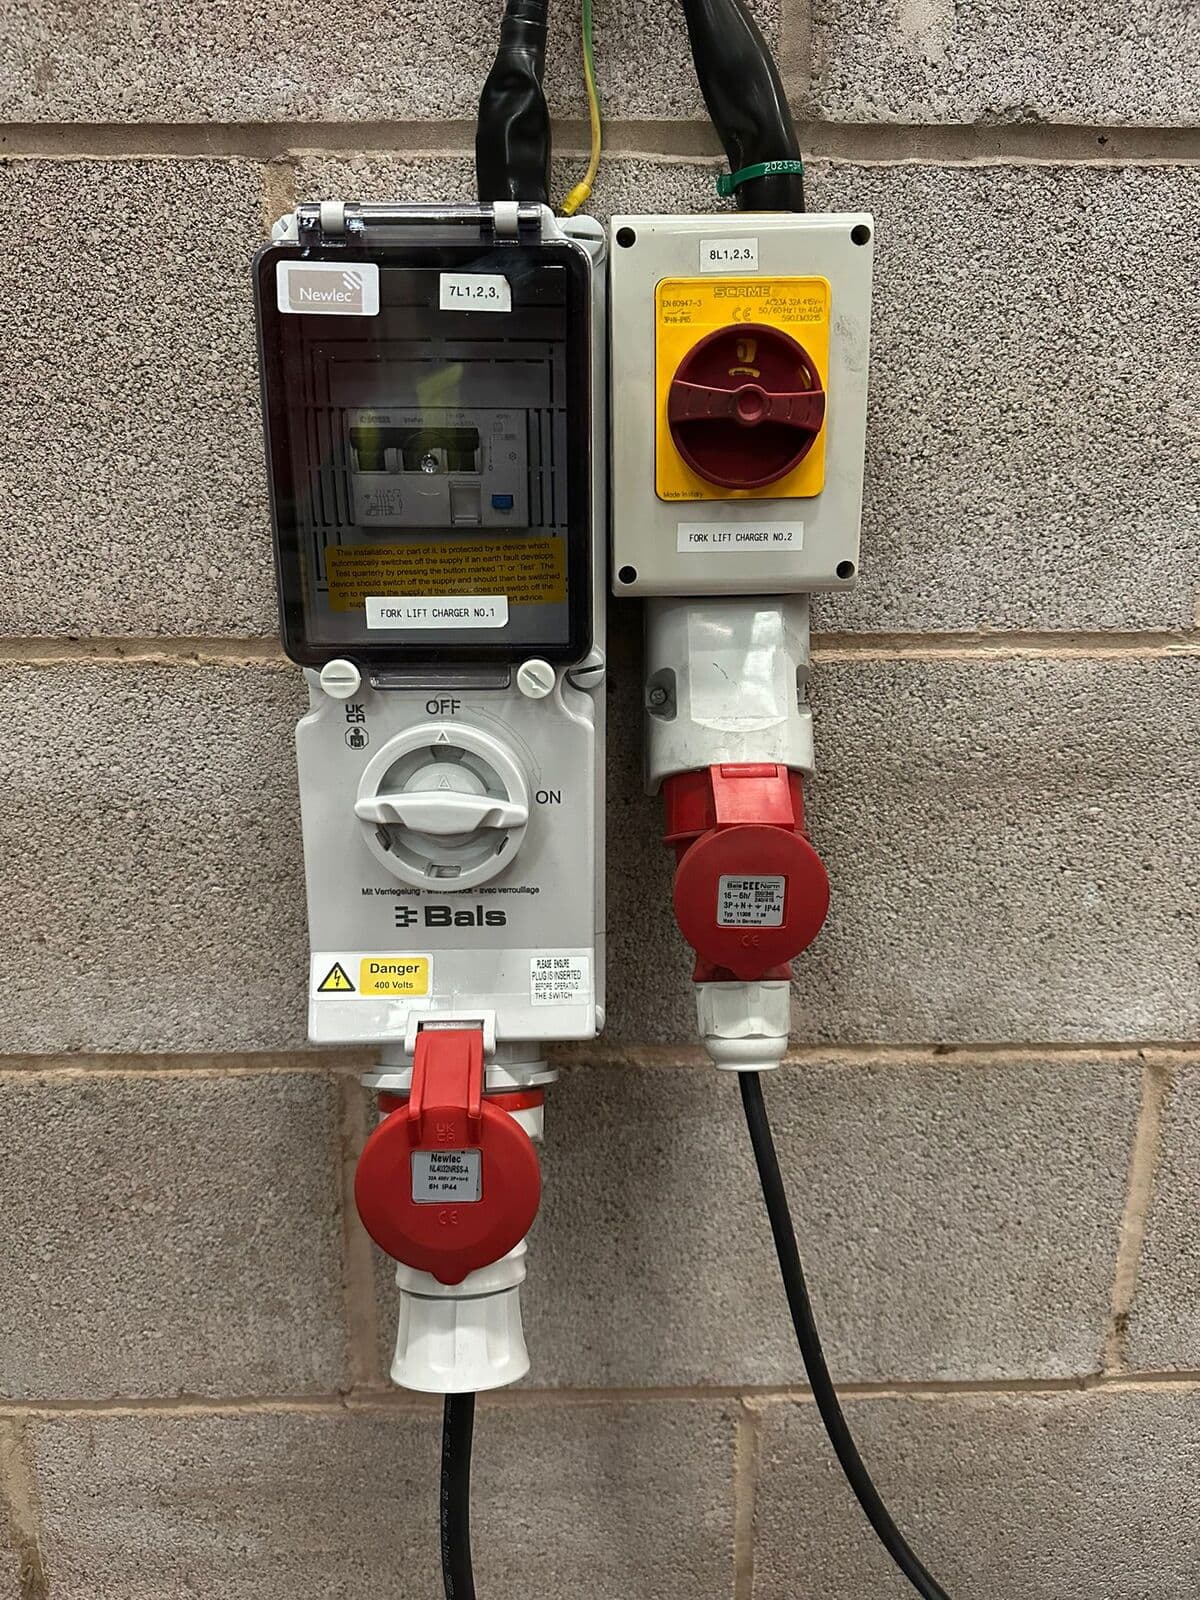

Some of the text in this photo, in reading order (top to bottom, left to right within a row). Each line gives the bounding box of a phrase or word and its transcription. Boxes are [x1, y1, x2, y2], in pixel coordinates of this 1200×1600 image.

[300, 287, 352, 303] Newlec
[449, 286, 500, 300] 7L1,2,3,
[713, 286, 771, 298] SCAME
[689, 532, 793, 542] FORK LIFT CHARGER NO.2
[380, 608, 495, 618] FORK LIFT CHARGER NO.1
[345, 704, 365, 713] UK
[426, 700, 461, 715] OFF
[346, 714, 366, 723] CA
[536, 790, 561, 804] ON
[764, 904, 781, 912] IP44
[424, 905, 507, 927] Bals
[370, 963, 420, 975] Danger
[392, 981, 413, 989] Volts
[431, 1153, 461, 1163] Newlec
